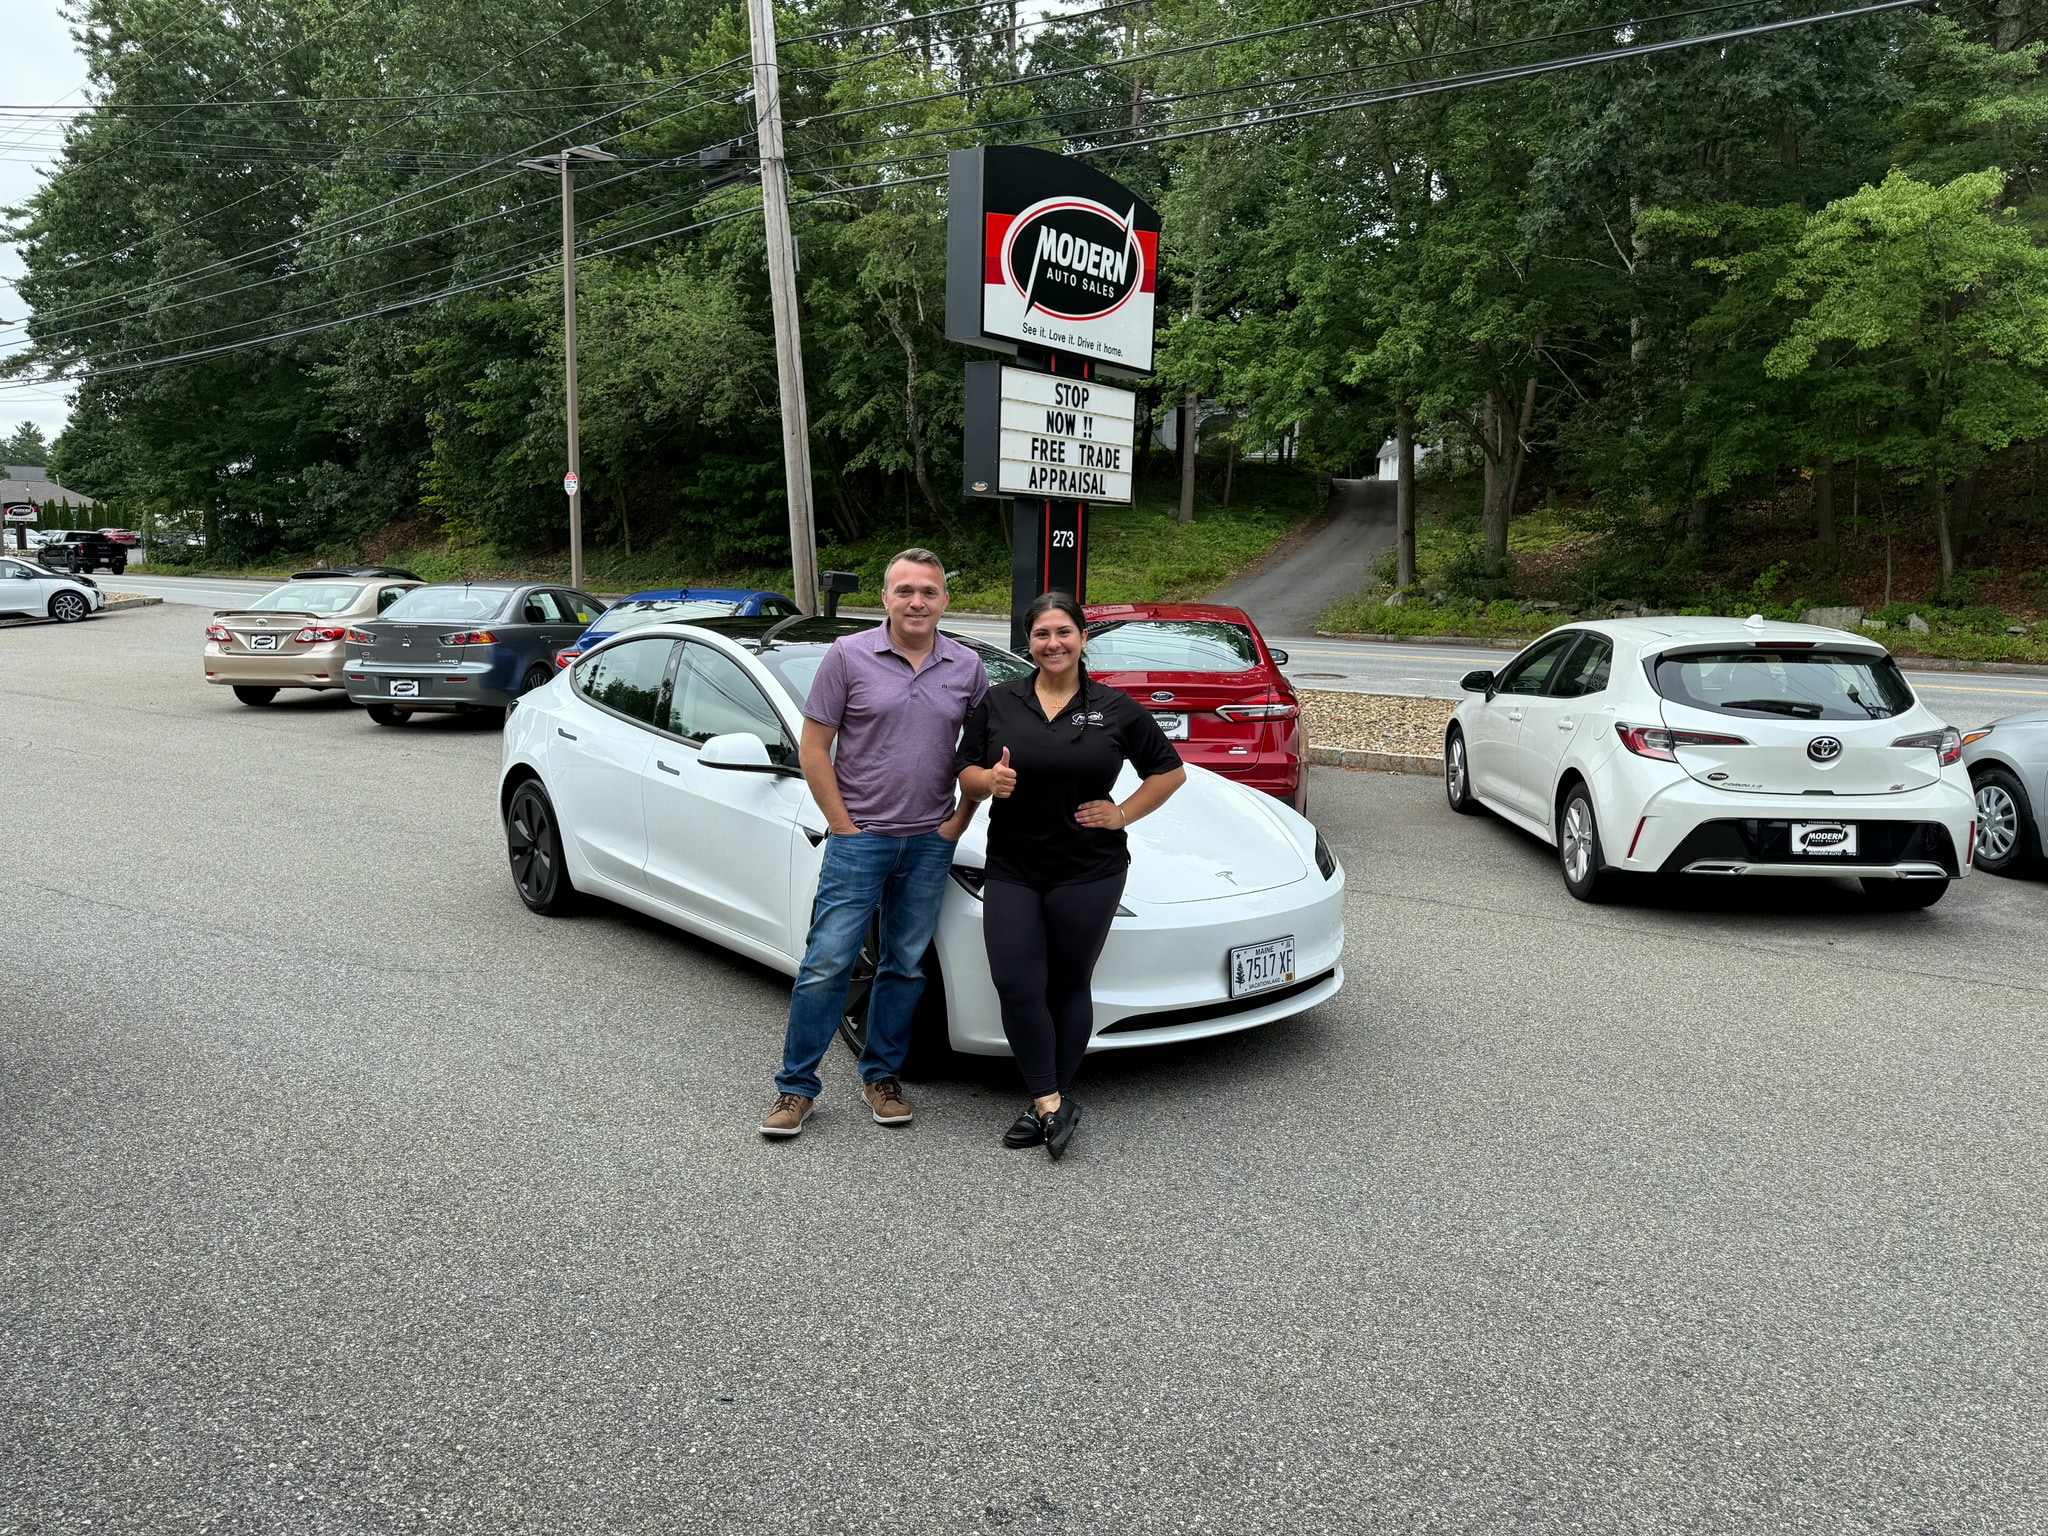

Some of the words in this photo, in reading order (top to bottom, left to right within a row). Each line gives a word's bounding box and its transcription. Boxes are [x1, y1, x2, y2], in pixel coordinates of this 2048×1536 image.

[1034, 216, 1130, 290] MODERN
[1046, 267, 1077, 287] AUTO
[1082, 278, 1115, 298] SALES
[1022, 322, 1037, 335] See
[1039, 326, 1047, 338] it.
[1048, 329, 1066, 343] Love
[1077, 336, 1094, 350] Drive
[1096, 341, 1102, 352] it
[1103, 343, 1123, 357] home.
[1054, 382, 1090, 409] STOP
[1046, 410, 1076, 436] NOW
[1083, 416, 1093, 439] !!
[1031, 437, 1065, 463] FREE
[1079, 444, 1120, 470] TRADE
[1028, 466, 1106, 495] APPRAISAL
[1052, 530, 1074, 548] 273
[1246, 953, 1276, 982] 7517
[1279, 949, 1293, 974] XF
[1255, 946, 1274, 955] MAINE
